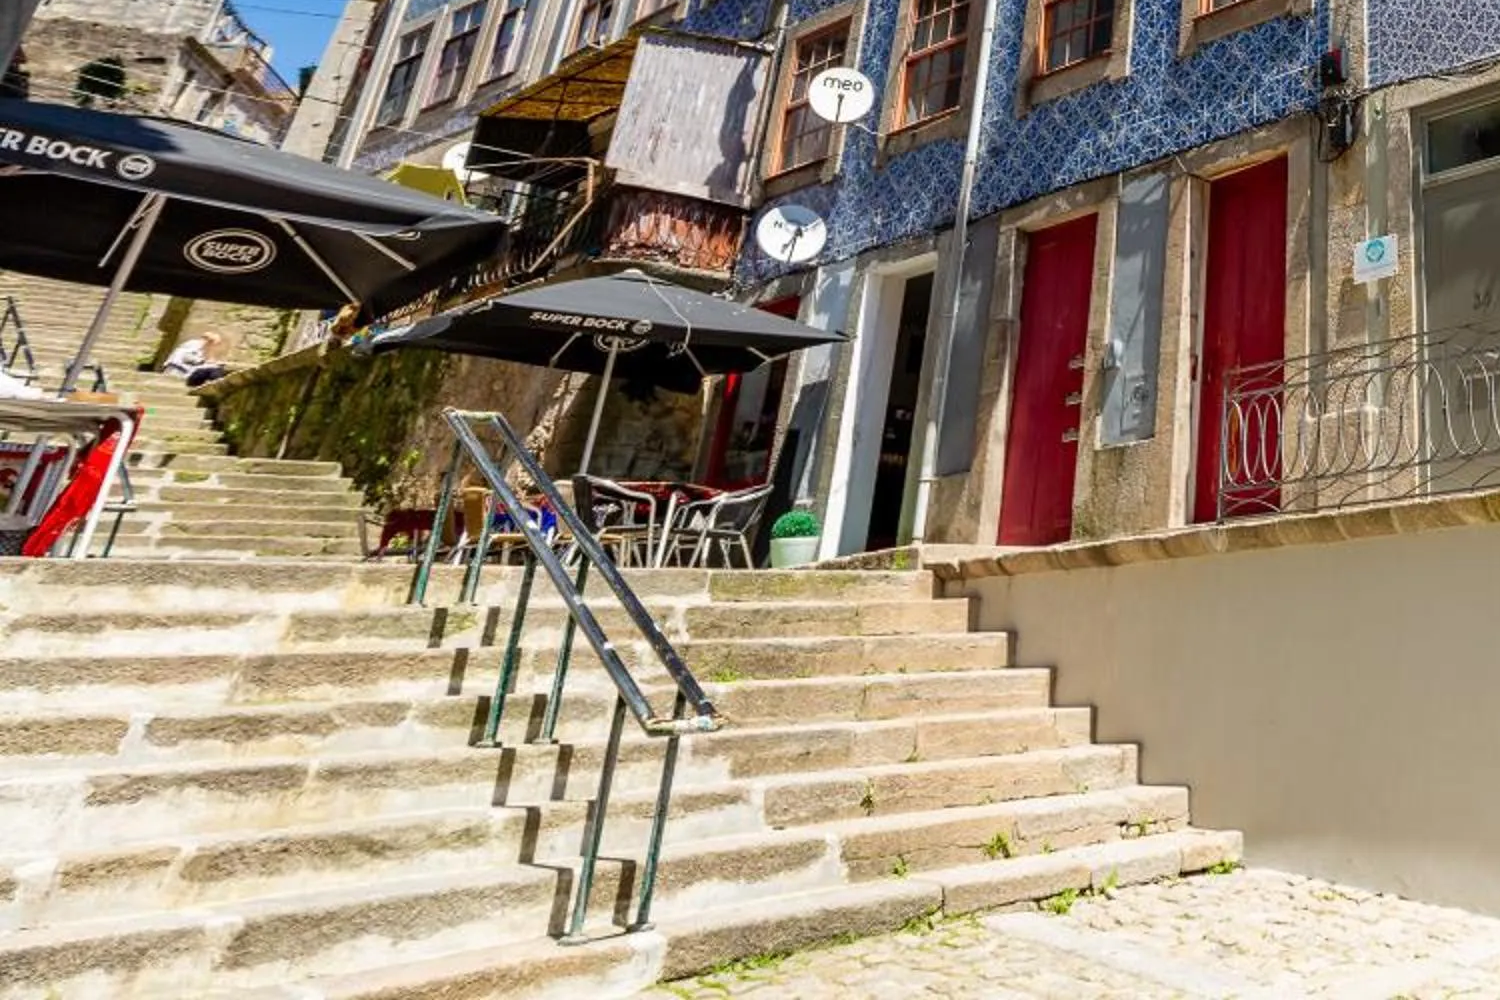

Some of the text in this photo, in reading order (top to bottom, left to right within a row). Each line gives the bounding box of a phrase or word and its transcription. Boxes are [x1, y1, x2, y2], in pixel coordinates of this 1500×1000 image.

[823, 76, 864, 92] meo
[24, 135, 112, 169] BOCK
[201, 248, 253, 263] BOCK
[203, 241, 261, 257] SUPER
[529, 311, 582, 326] SUPER
[583, 317, 629, 330] BOCK
